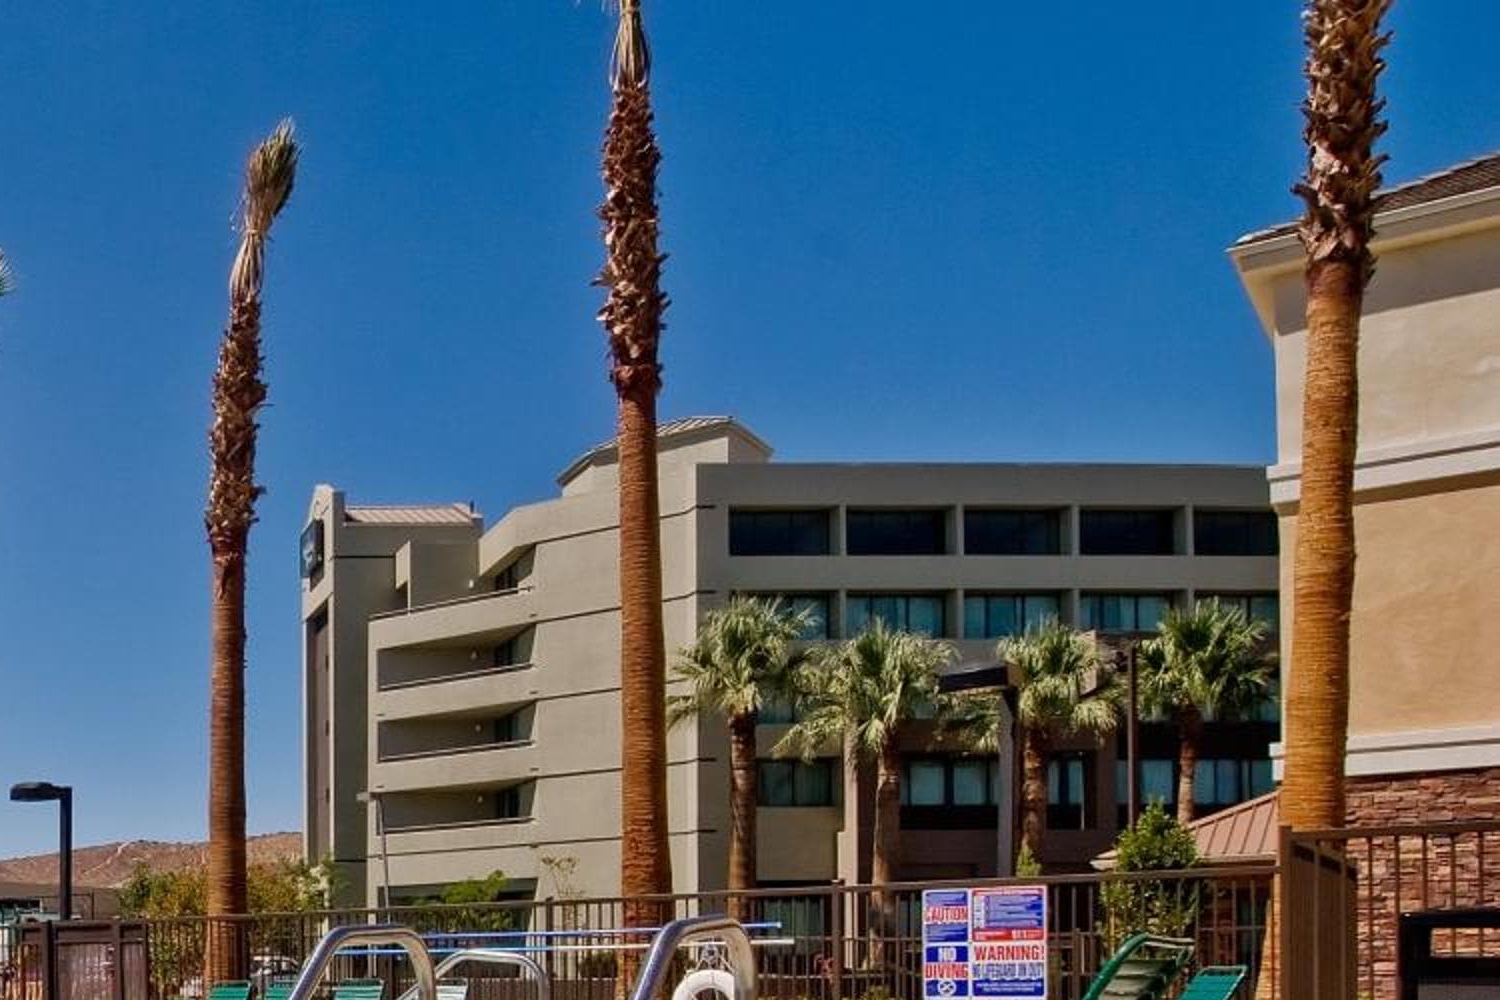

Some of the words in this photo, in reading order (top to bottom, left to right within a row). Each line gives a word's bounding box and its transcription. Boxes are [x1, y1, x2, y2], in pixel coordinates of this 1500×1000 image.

[925, 907, 968, 922] CAUTION
[974, 945, 1045, 961] WARNING!
[925, 963, 968, 979] DIVING
